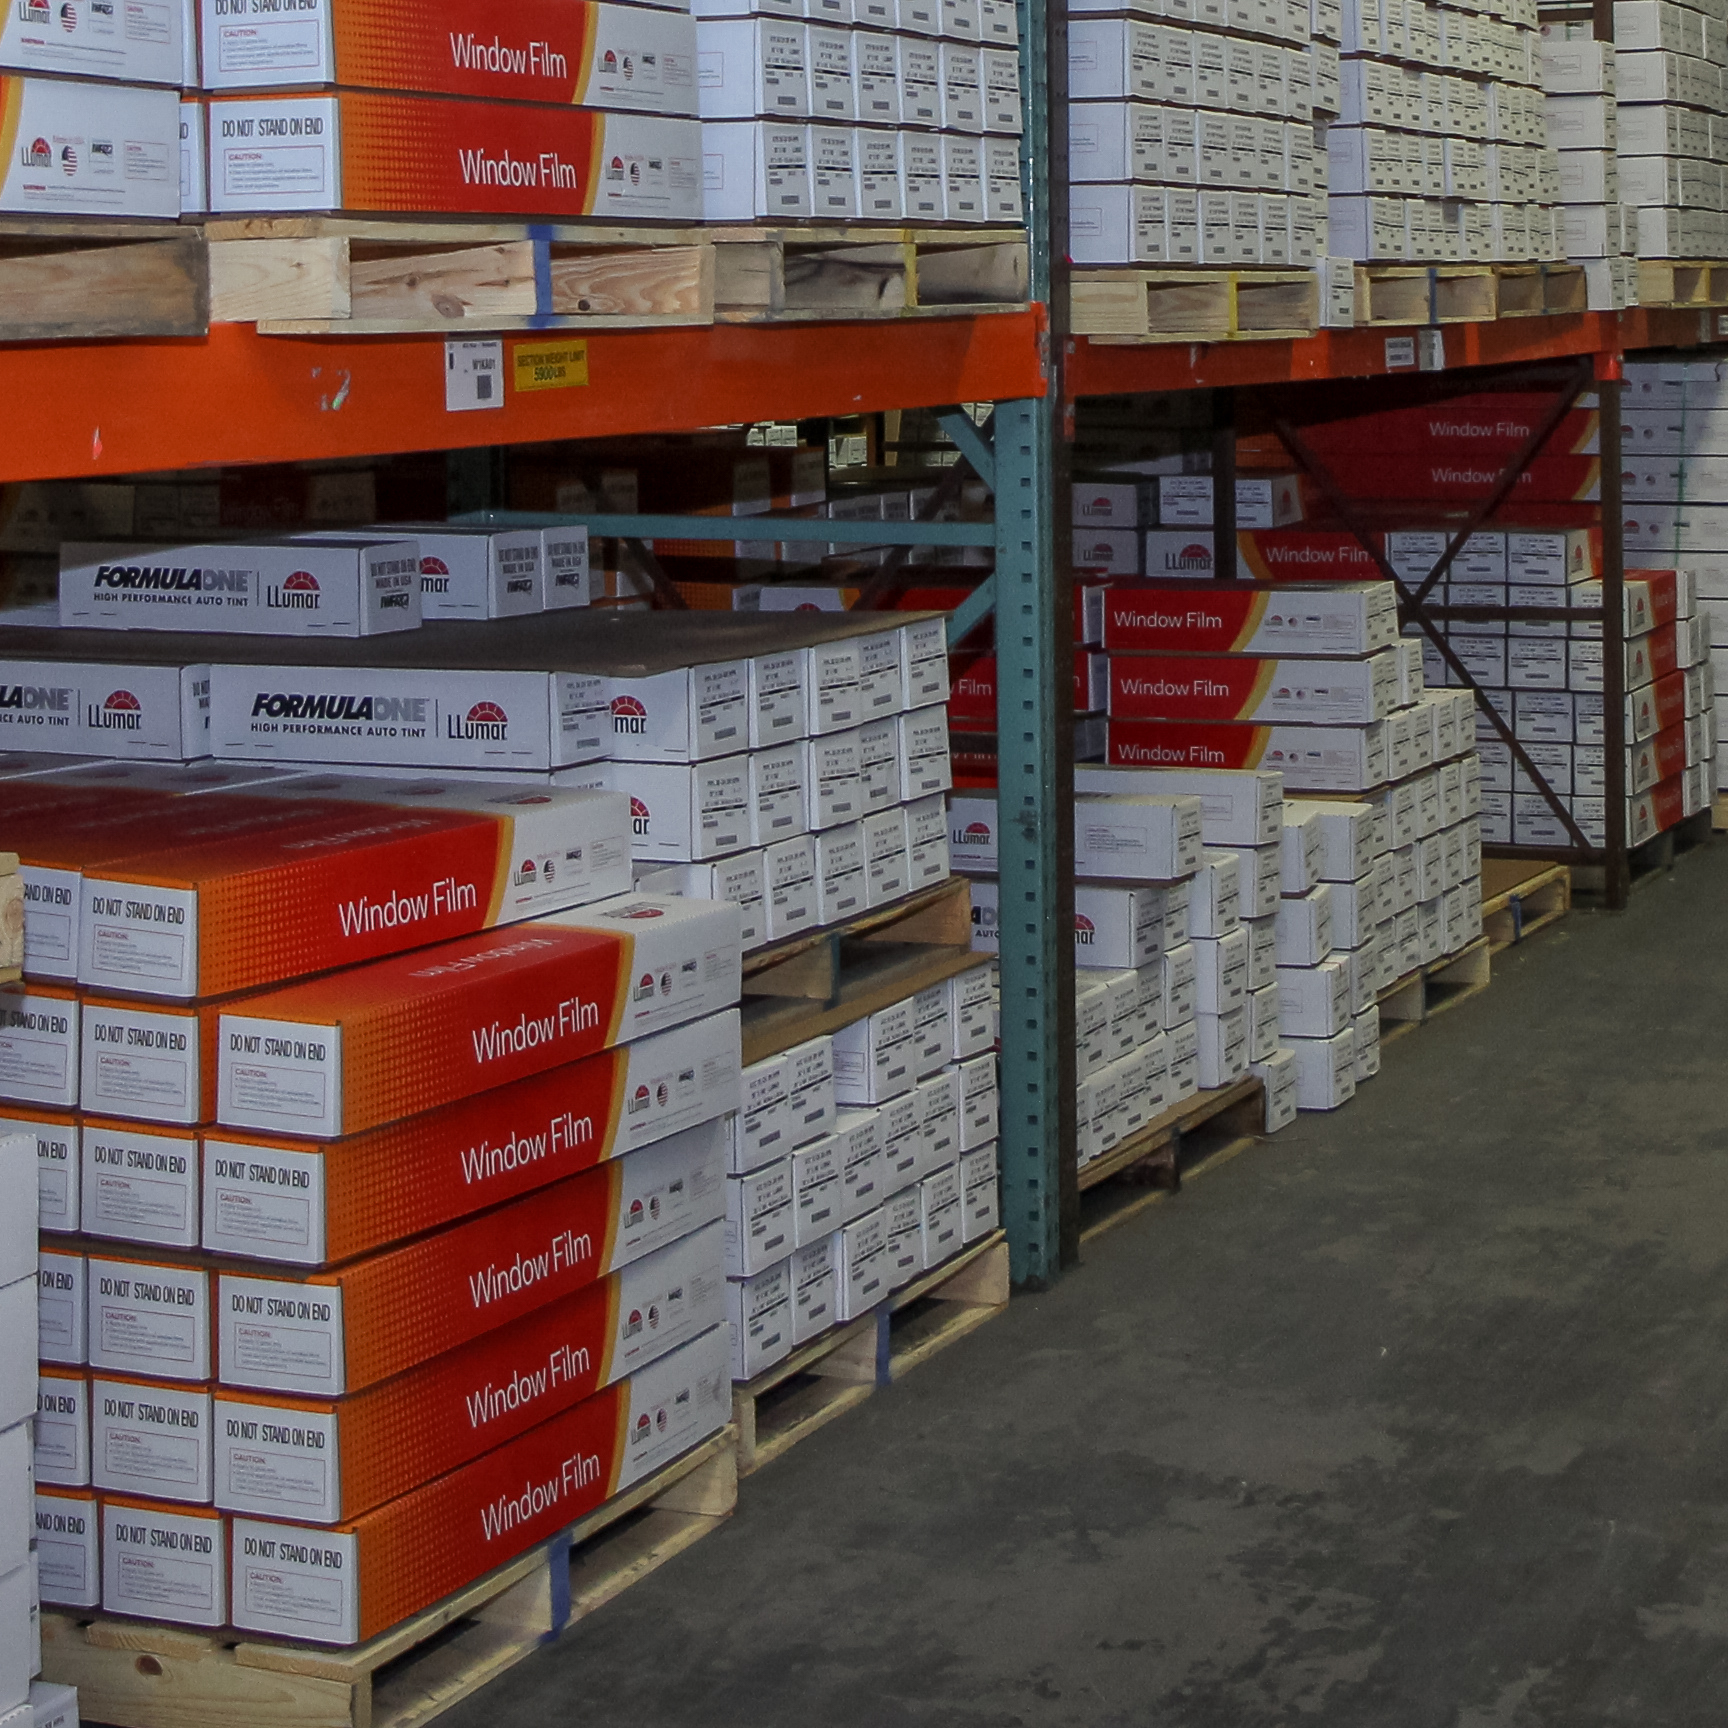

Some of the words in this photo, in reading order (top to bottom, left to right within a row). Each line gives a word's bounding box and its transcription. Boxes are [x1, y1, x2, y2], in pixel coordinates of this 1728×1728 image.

[450, 33, 526, 74] Window
[530, 42, 566, 78] Film
[459, 148, 536, 186] Window
[540, 153, 576, 188] Film
[94, 593, 118, 601] HIGH
[122, 594, 191, 604] PERFORMANCE
[196, 597, 222, 605] AUTO
[227, 597, 248, 606] TINT
[267, 584, 320, 609] LLumar
[1114, 611, 1182, 627] Window
[1187, 612, 1221, 628] Film
[1121, 679, 1189, 695] Window
[1194, 680, 1228, 696] Film
[17, 715, 44, 725] AUTO
[48, 717, 69, 726] TINT
[89, 704, 141, 730] LLumar
[251, 723, 278, 732] HIGH
[283, 724, 361, 735] PERFORMANCE
[367, 727, 397, 737] AUTO
[401, 728, 425, 737] TINT
[447, 714, 507, 741] LLumar
[1118, 745, 1185, 761] Window
[1190, 746, 1224, 762] Film
[339, 890, 428, 936] Window
[433, 878, 476, 915] Film
[473, 1014, 554, 1063] Window
[559, 997, 598, 1036] Film
[461, 1132, 546, 1184] Window
[551, 1113, 592, 1153] Film
[470, 1252, 548, 1307] Window
[552, 1230, 591, 1272] Film
[466, 1368, 546, 1427] Window
[550, 1345, 589, 1387] Film
[481, 1478, 558, 1540] Window
[562, 1453, 599, 1496] Film
